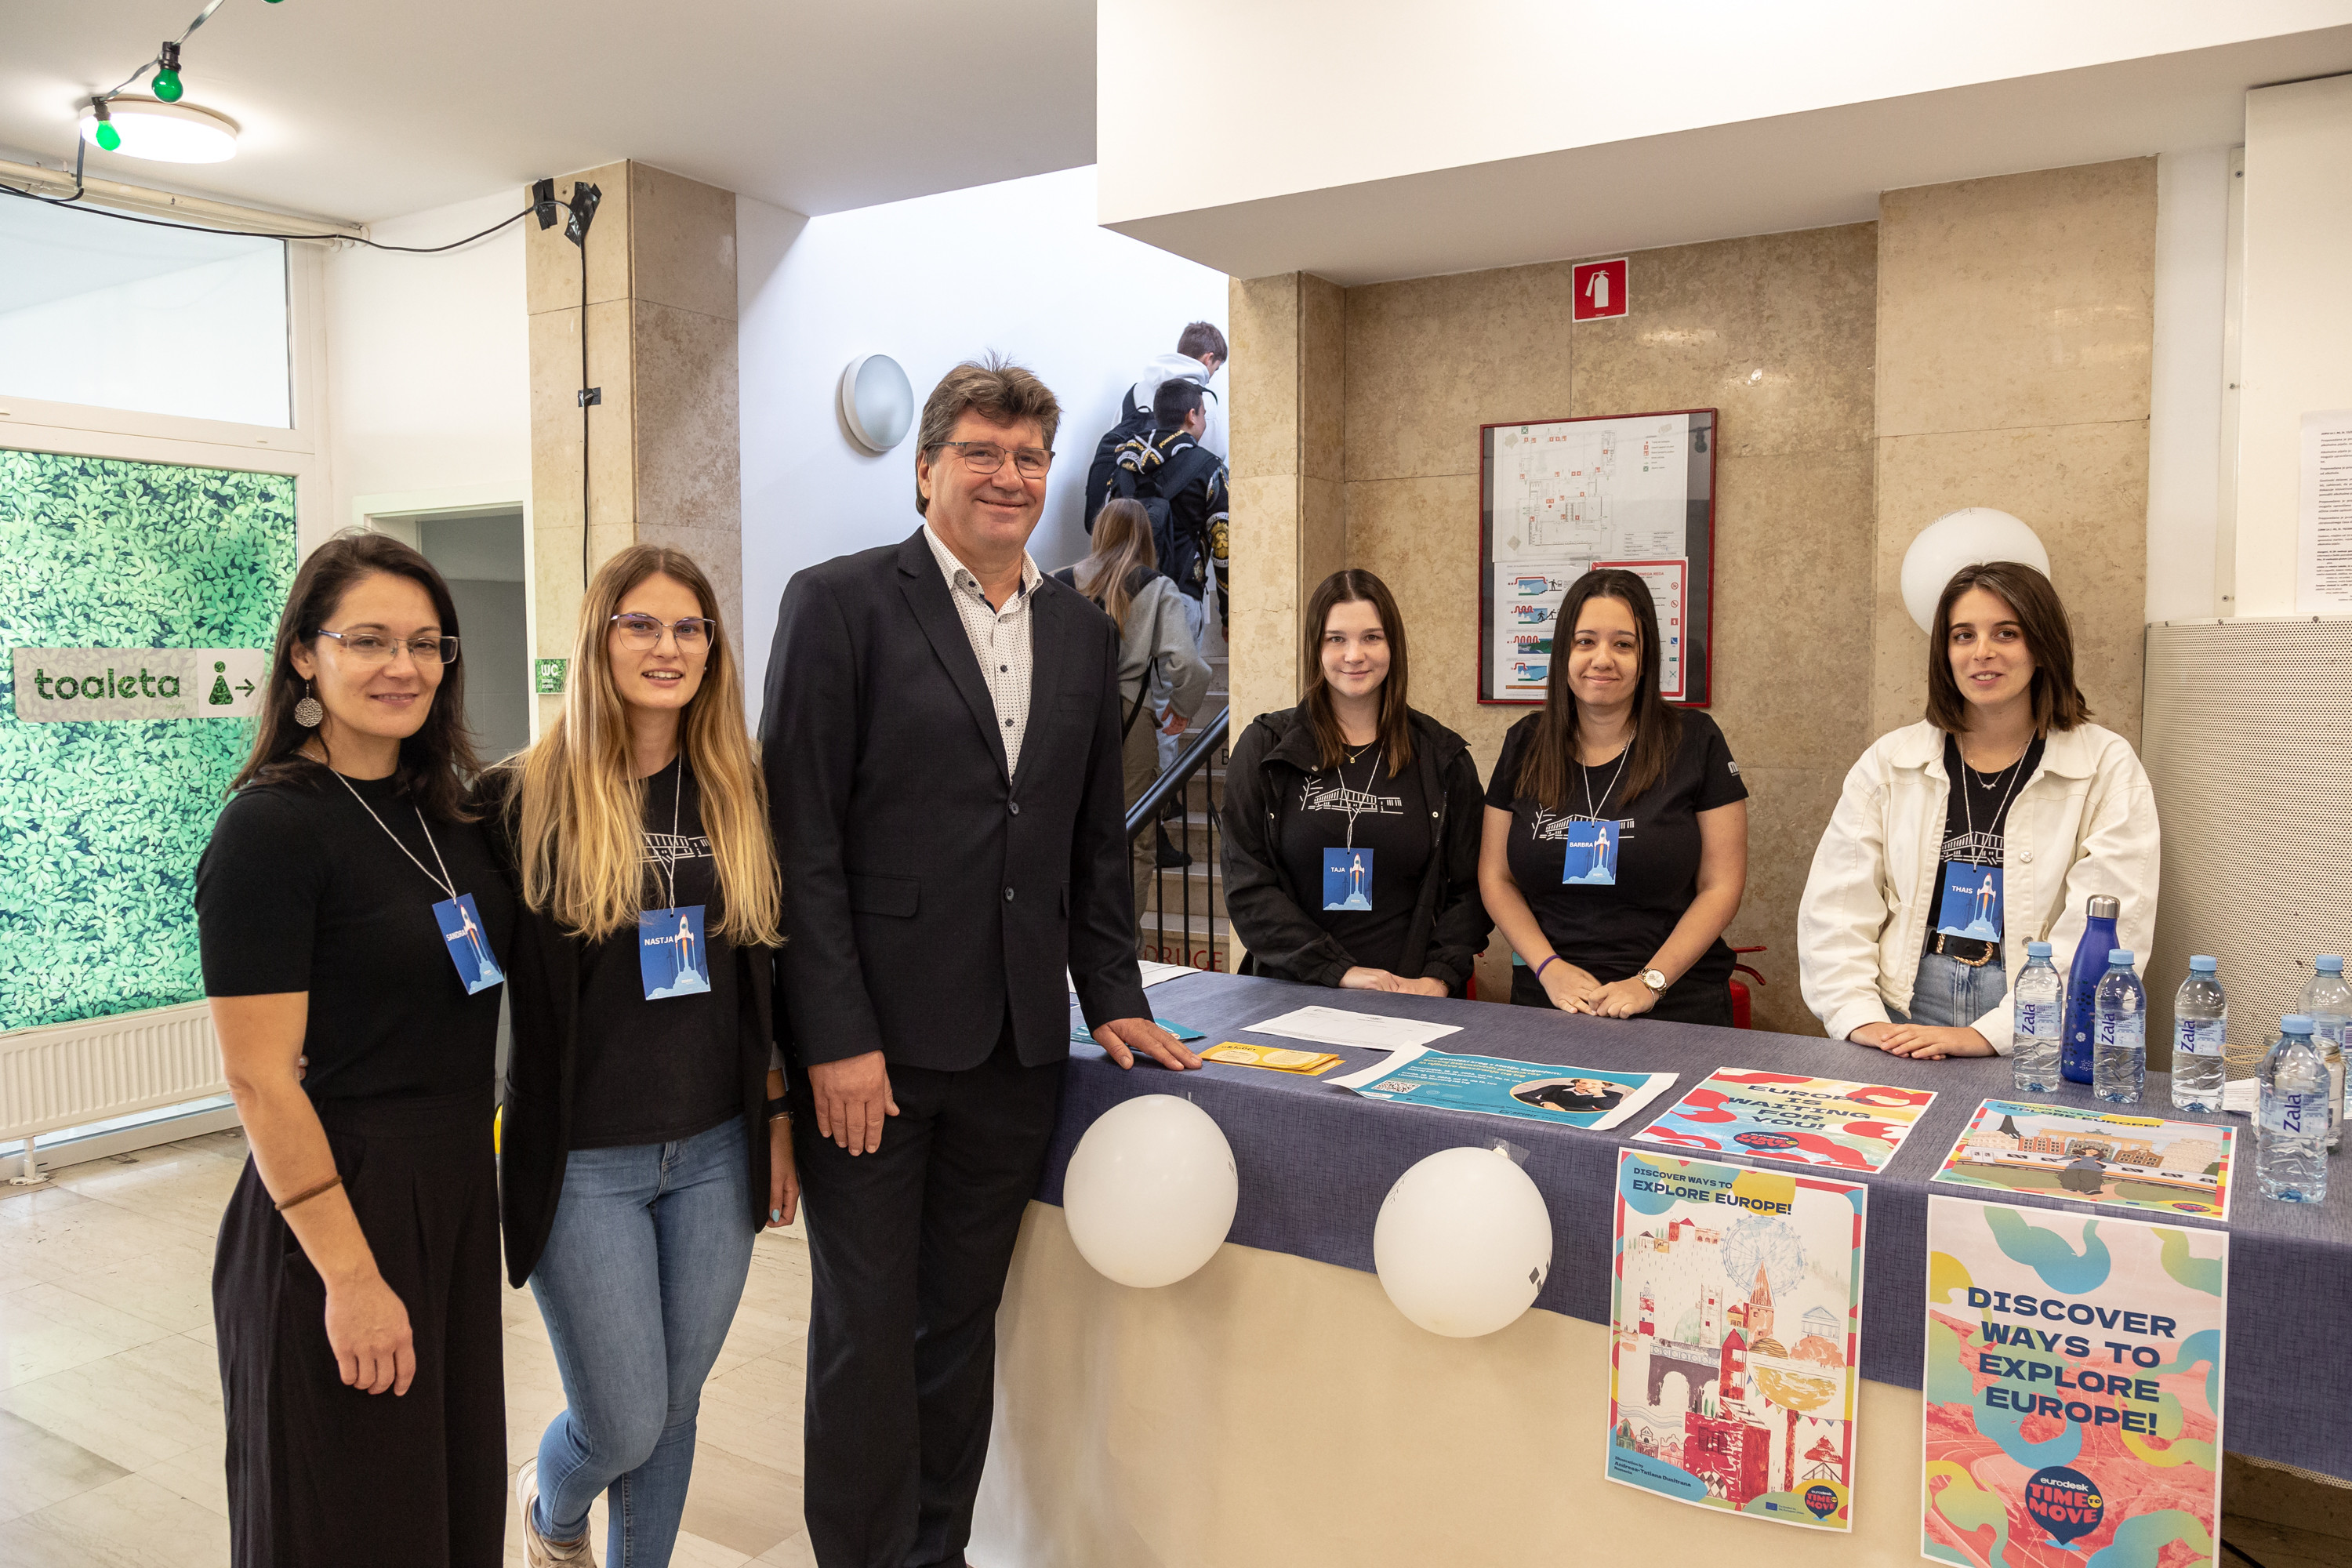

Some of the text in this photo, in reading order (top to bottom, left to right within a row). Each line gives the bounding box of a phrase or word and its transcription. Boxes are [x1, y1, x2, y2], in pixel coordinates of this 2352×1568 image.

[541, 664, 558, 676] WC
[34, 668, 180, 700] toaleta
[1952, 885, 1973, 894] THAIS
[446, 929, 466, 941] SANDRA
[644, 936, 673, 946] NASTJA
[1144, 945, 1223, 972] DRUGE
[2022, 1004, 2036, 1035] Zala
[2101, 1013, 2115, 1045] Zala
[2180, 1020, 2196, 1053] Zala
[1497, 1068, 1541, 1076] produktov
[1748, 1085, 1875, 1105] EUROPE
[1785, 1097, 1823, 1105] IS
[1728, 1097, 1871, 1119] WAITING
[1757, 1109, 1824, 1121] FOR
[1997, 1105, 2076, 1119] EXPLORE
[2283, 1093, 2302, 1133] Zala
[1751, 1116, 1826, 1130] YOU!
[1633, 1167, 1733, 1189] DISCOVER WAYS TO
[1632, 1179, 1792, 1215] EXPLORE EUROPE!
[1967, 1287, 2176, 1338] DISCOVER
[1980, 1320, 2161, 1369] WAYS TO
[1978, 1353, 2160, 1403] EXPLORE
[1985, 1386, 2158, 1436] EUROPE!
[1614, 1466, 1633, 1475] Romania
[2029, 1483, 2089, 1508] TIME
[2040, 1477, 2089, 1492] eurodesk
[1806, 1499, 1835, 1511] MOVE
[1807, 1493, 1831, 1503] TIME
[2029, 1497, 2098, 1524] MOVE
